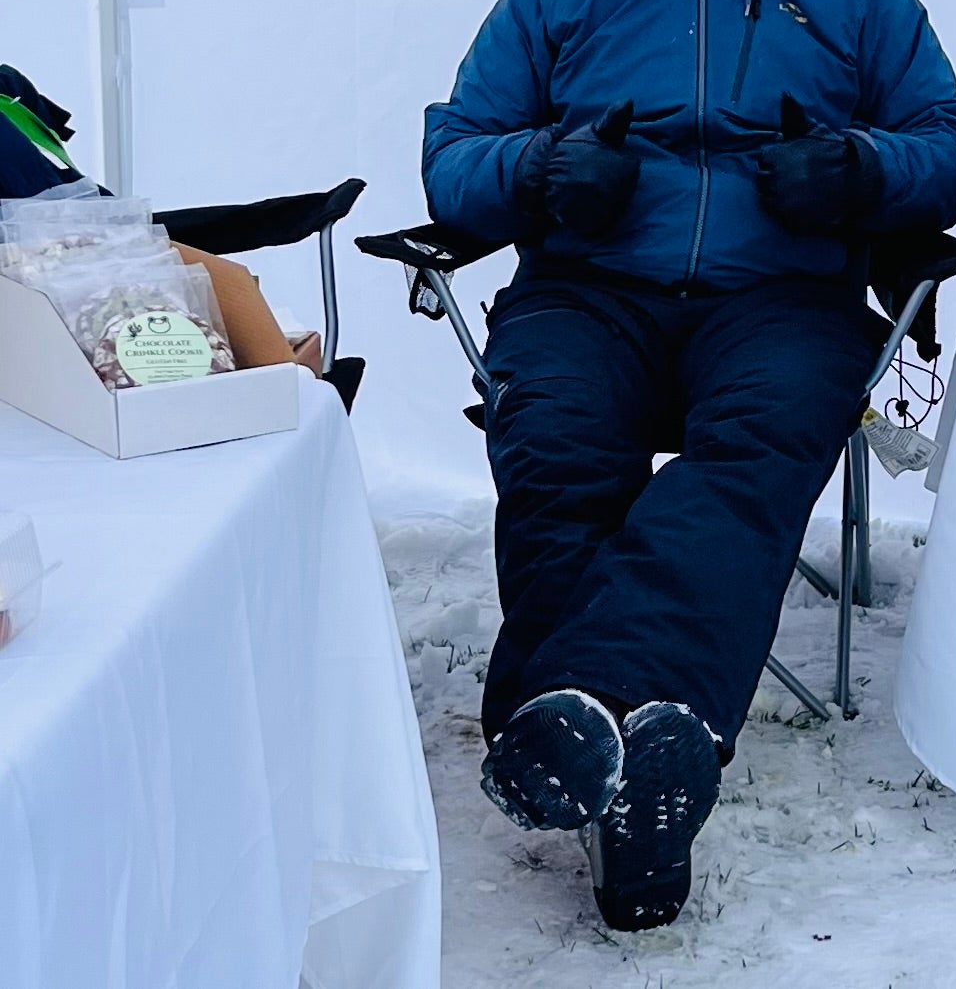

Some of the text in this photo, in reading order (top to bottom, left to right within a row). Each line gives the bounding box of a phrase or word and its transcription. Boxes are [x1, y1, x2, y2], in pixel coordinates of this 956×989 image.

[134, 339, 191, 347] CHOCOLATE
[125, 348, 203, 357] CRINKLE COOKIE
